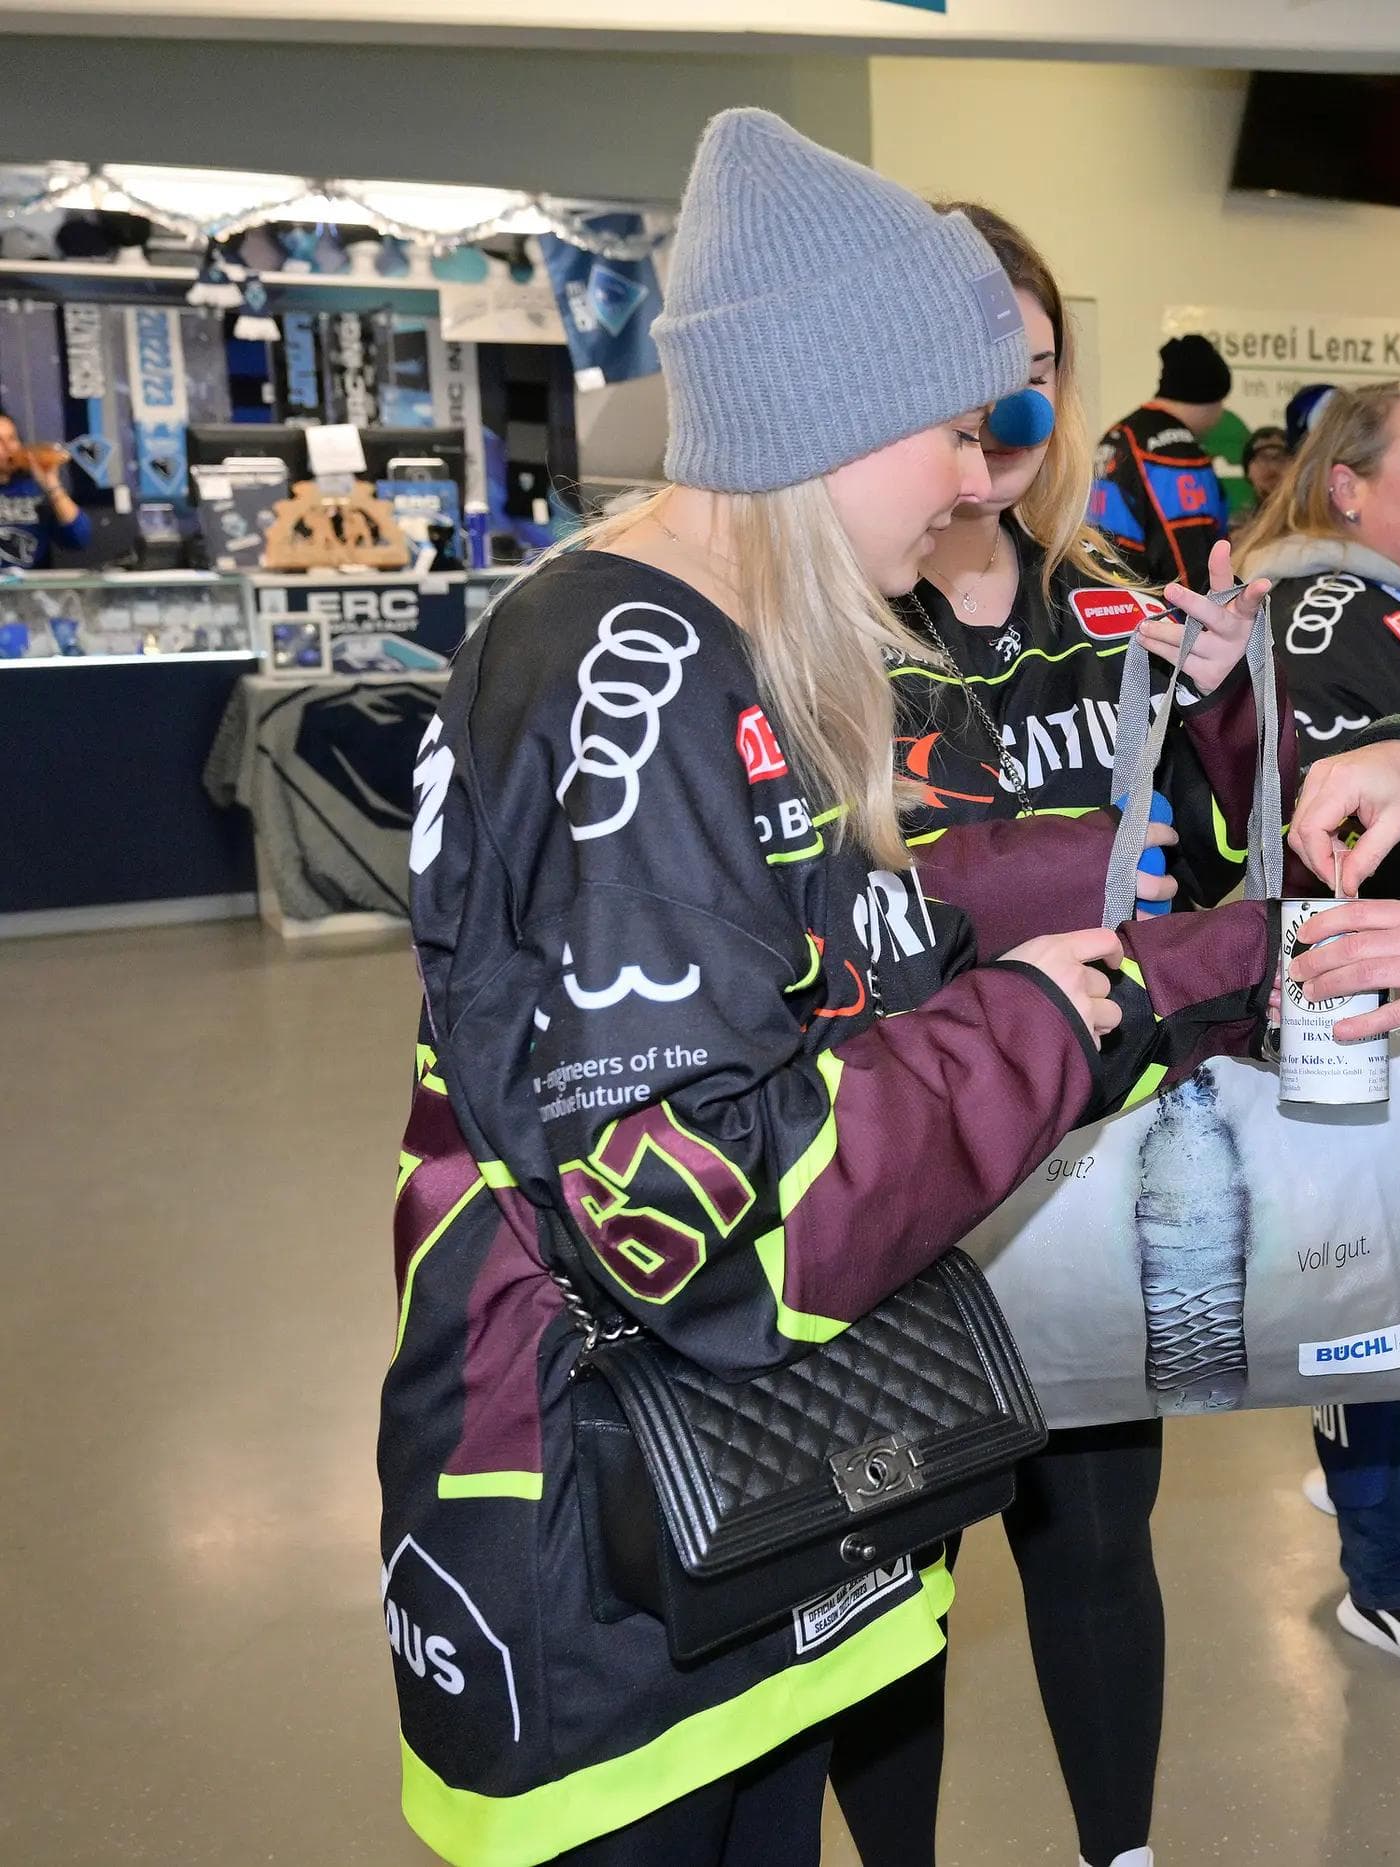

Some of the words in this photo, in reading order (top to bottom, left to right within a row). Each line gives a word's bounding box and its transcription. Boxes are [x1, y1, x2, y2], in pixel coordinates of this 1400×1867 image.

[1308, 329, 1374, 363] Lenz
[307, 590, 419, 621] ERC
[1084, 603, 1134, 618] PENNY
[630, 1046, 658, 1072] of
[664, 1045, 708, 1069] the
[1301, 1055, 1325, 1065] Kids
[1046, 1156, 1095, 1181] gut?
[1297, 1248, 1329, 1272] Voll
[1335, 1236, 1371, 1269] gut.
[1316, 1336, 1393, 1362] BÜCHL
